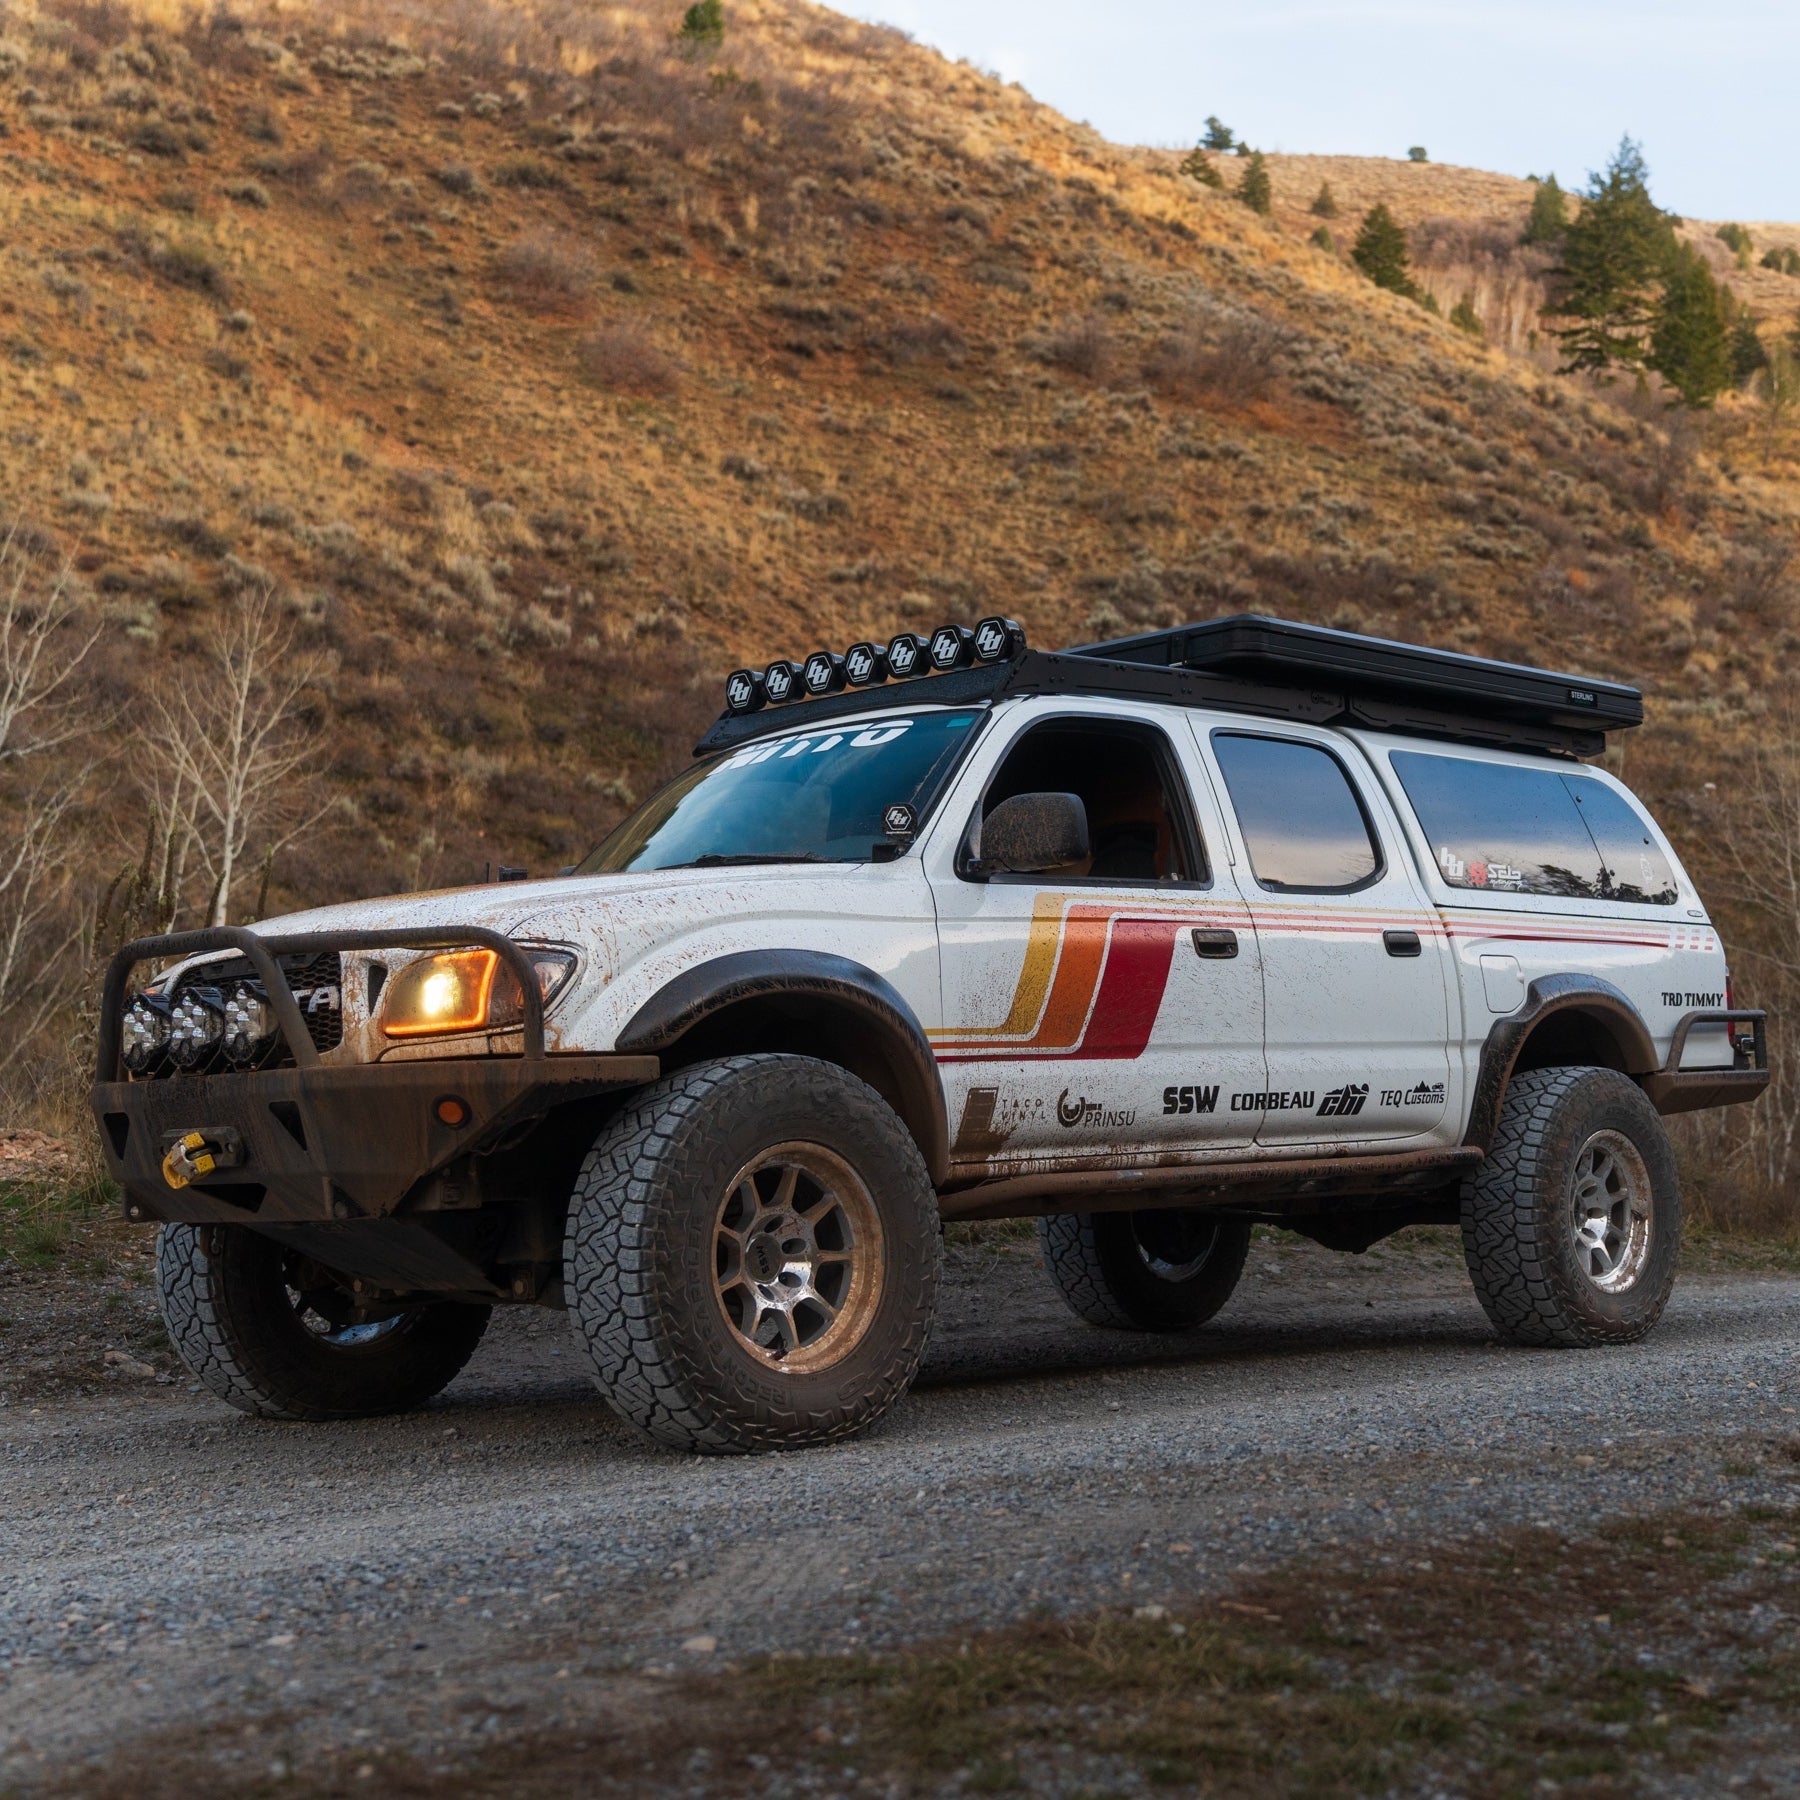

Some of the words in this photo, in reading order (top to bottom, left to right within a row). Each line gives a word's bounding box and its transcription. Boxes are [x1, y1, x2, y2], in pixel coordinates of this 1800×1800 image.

[933, 634, 958, 659] bd
[977, 626, 1003, 651] bd
[848, 652, 870, 675] bd
[891, 642, 914, 667] bd
[768, 669, 790, 693] bd
[807, 661, 829, 685] bd
[728, 678, 749, 702] bd
[1661, 992, 1683, 1007] TRD
[1685, 992, 1724, 1007] TIMMY
[1001, 1097, 1045, 1109] TACO
[1162, 1085, 1221, 1115] SSW
[1230, 1090, 1315, 1112] CORBEAU
[1379, 1089, 1402, 1108] TEQ
[1404, 1089, 1445, 1105] Customs
[1000, 1109, 1047, 1121] VINYL
[1084, 1110, 1136, 1128] PRINSU
